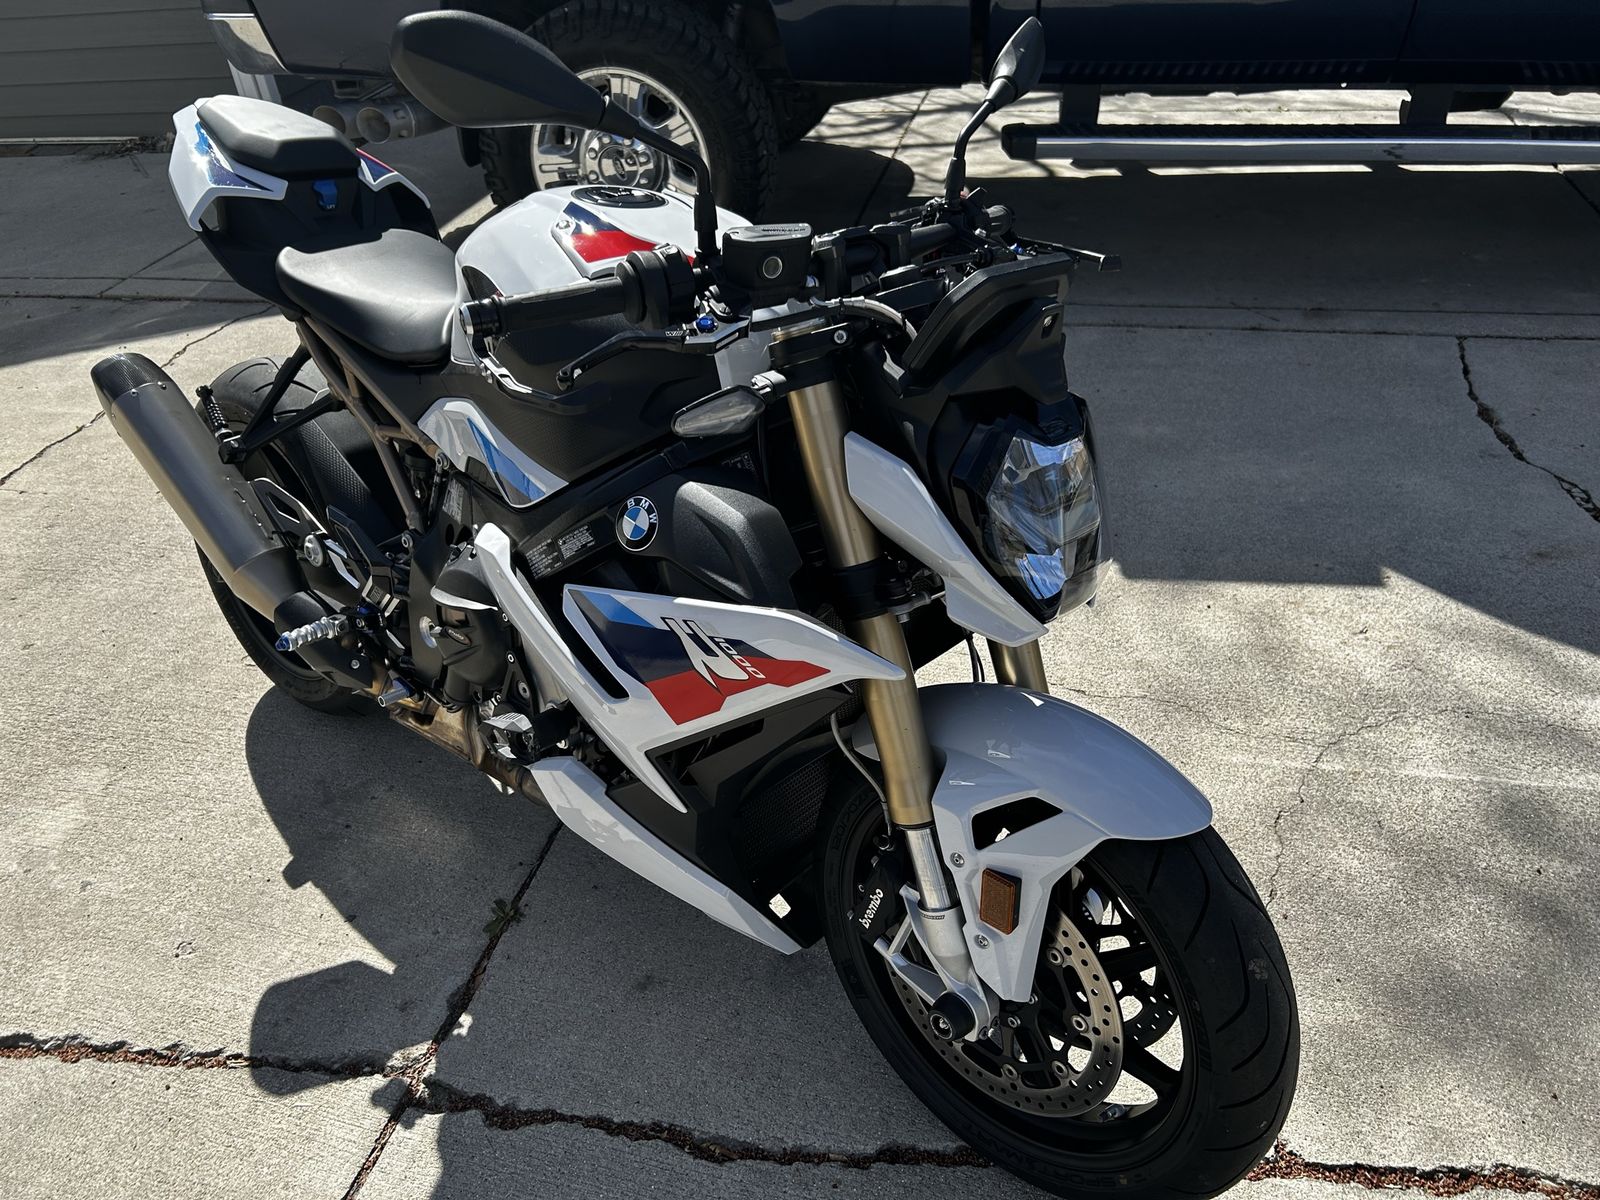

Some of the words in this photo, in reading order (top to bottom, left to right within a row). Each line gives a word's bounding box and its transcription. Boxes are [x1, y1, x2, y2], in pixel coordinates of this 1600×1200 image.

[627, 498, 657, 523] BMW
[713, 637, 766, 679] 1000
[858, 888, 884, 930] brembo
